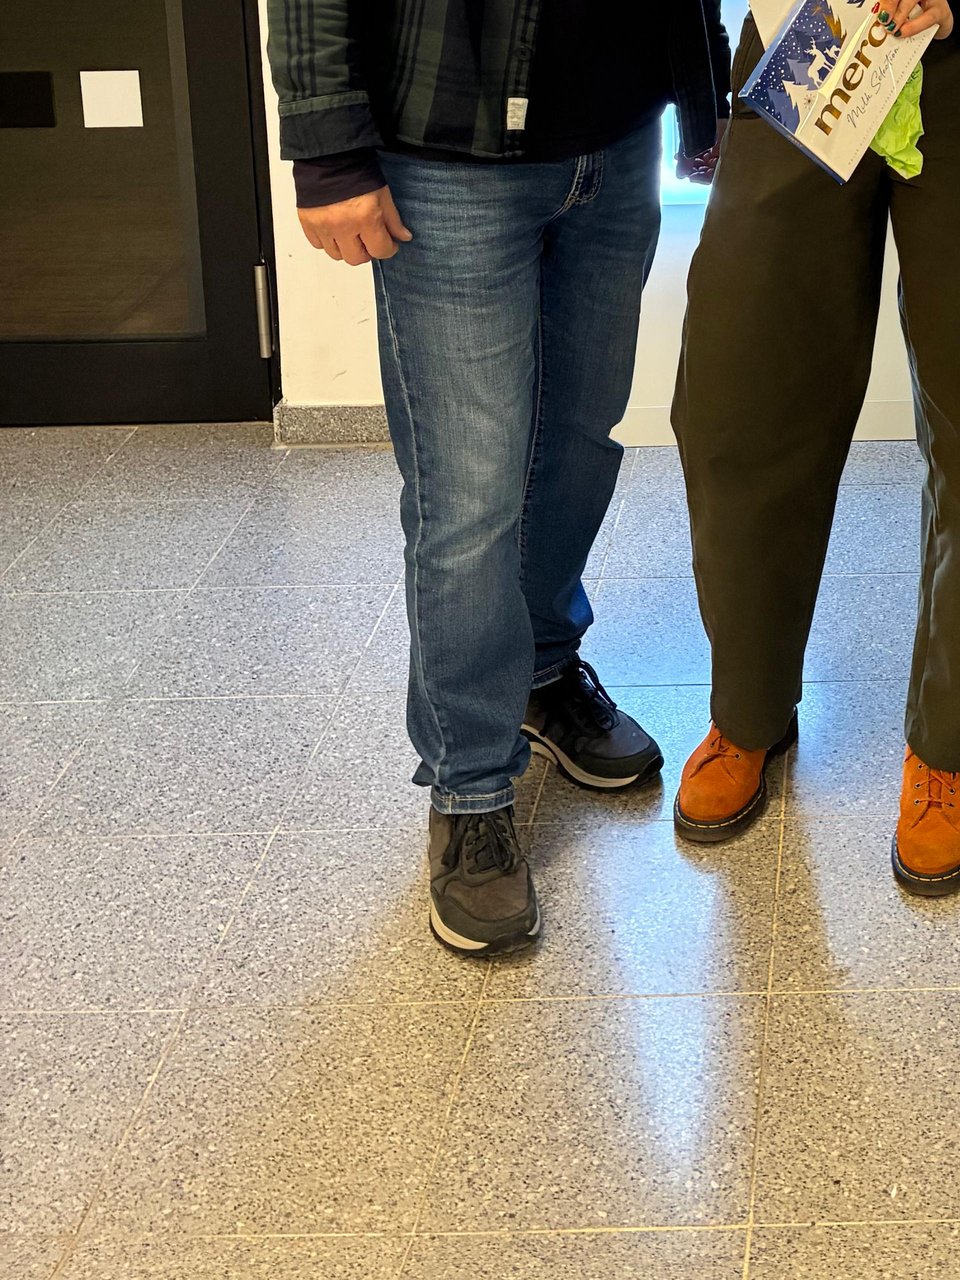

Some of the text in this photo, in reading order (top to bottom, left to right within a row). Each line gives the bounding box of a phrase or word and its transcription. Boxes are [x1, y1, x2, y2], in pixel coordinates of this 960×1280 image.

[814, 20, 889, 136] merc
[846, 91, 873, 129] Milk
[871, 46, 900, 95] Selection
